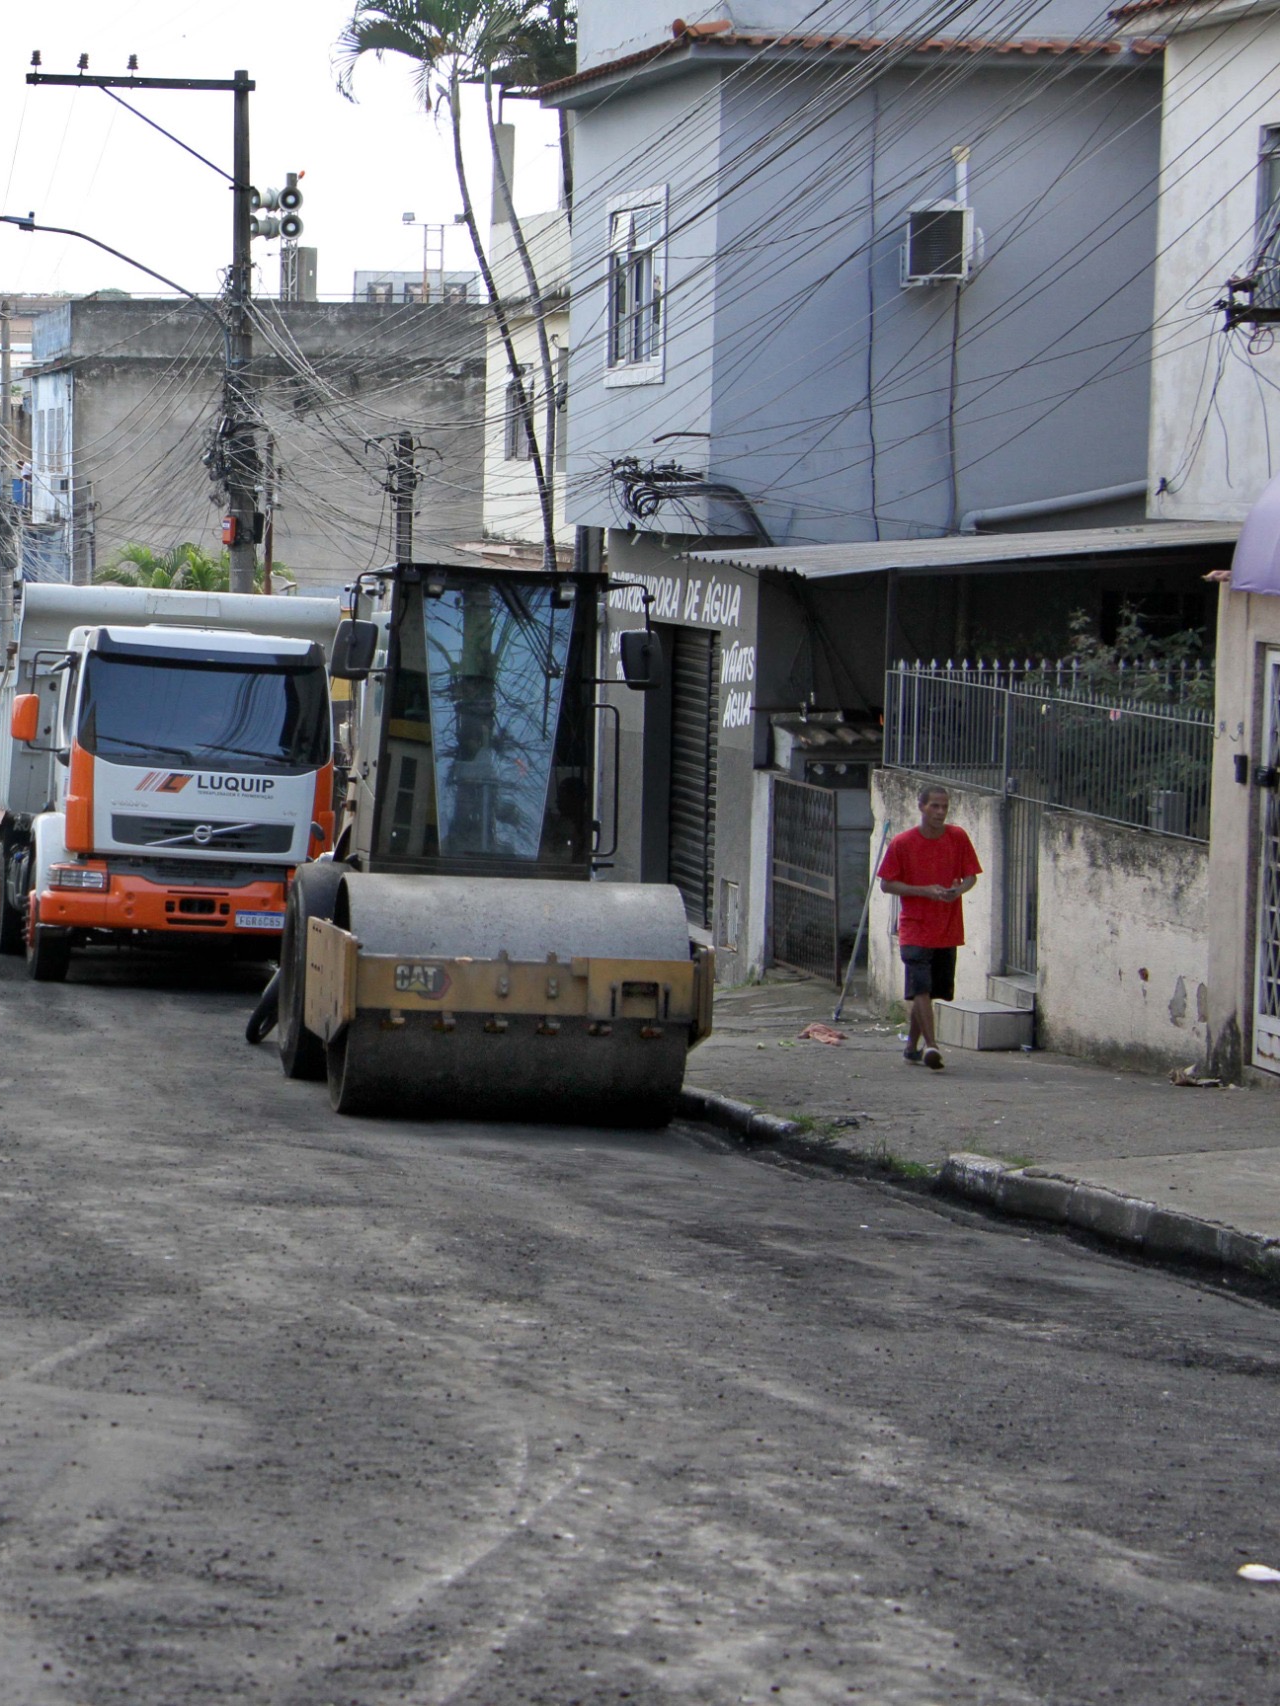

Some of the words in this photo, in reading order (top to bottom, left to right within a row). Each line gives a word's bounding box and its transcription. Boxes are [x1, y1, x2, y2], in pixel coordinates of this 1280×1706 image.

[684, 579, 702, 621] DE
[702, 575, 741, 627] ÁGUA
[721, 640, 756, 685] WHATS
[723, 688, 752, 728] ÁGUA
[197, 775, 275, 793] LUQUIP
[396, 965, 437, 991] CAT
